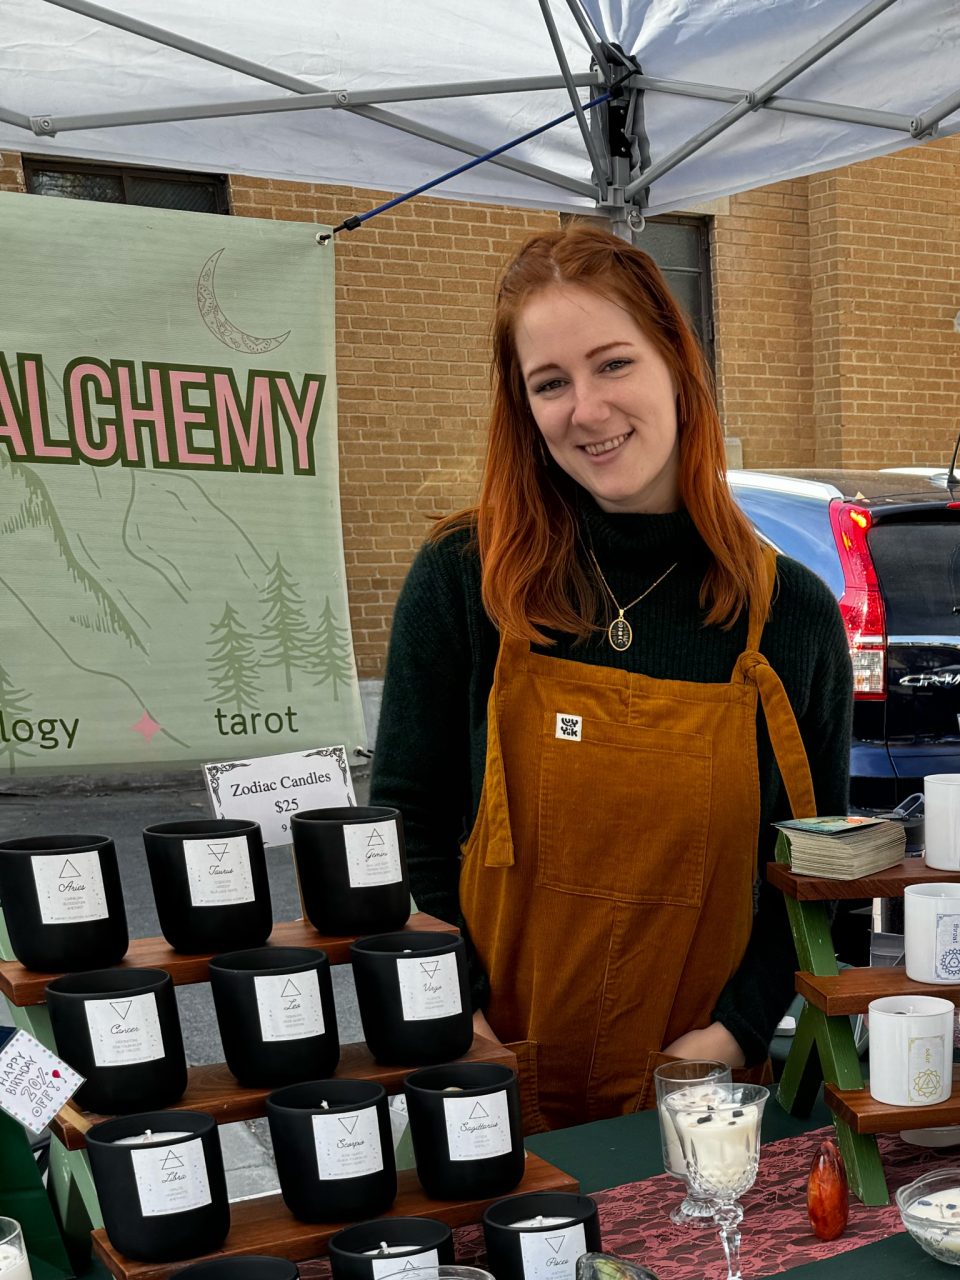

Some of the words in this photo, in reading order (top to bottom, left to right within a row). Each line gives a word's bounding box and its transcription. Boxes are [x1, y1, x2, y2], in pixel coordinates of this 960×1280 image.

[0, 354, 325, 475] ALCHEMY
[0, 710, 80, 750] logy
[214, 705, 299, 736] tarot
[230, 780, 277, 797] Zodiac
[280, 771, 332, 789] Candles
[274, 798, 299, 814] $25
[364, 848, 389, 862] Gemini
[208, 865, 234, 876] Taurus
[58, 880, 86, 893] Aries
[422, 982, 443, 994] Virgo
[283, 998, 301, 1011] Leo
[110, 1023, 141, 1036] Cancer
[0, 1051, 26, 1087] HAPPY
[6, 1055, 37, 1095] BIRTHDAY
[21, 1067, 49, 1102] 20%
[32, 1081, 60, 1117] OFF!
[460, 1121, 499, 1134] Sagittarius
[336, 1138, 365, 1150] Scorpio
[161, 1171, 187, 1183] Libra
[545, 1256, 569, 1268] Pisces
